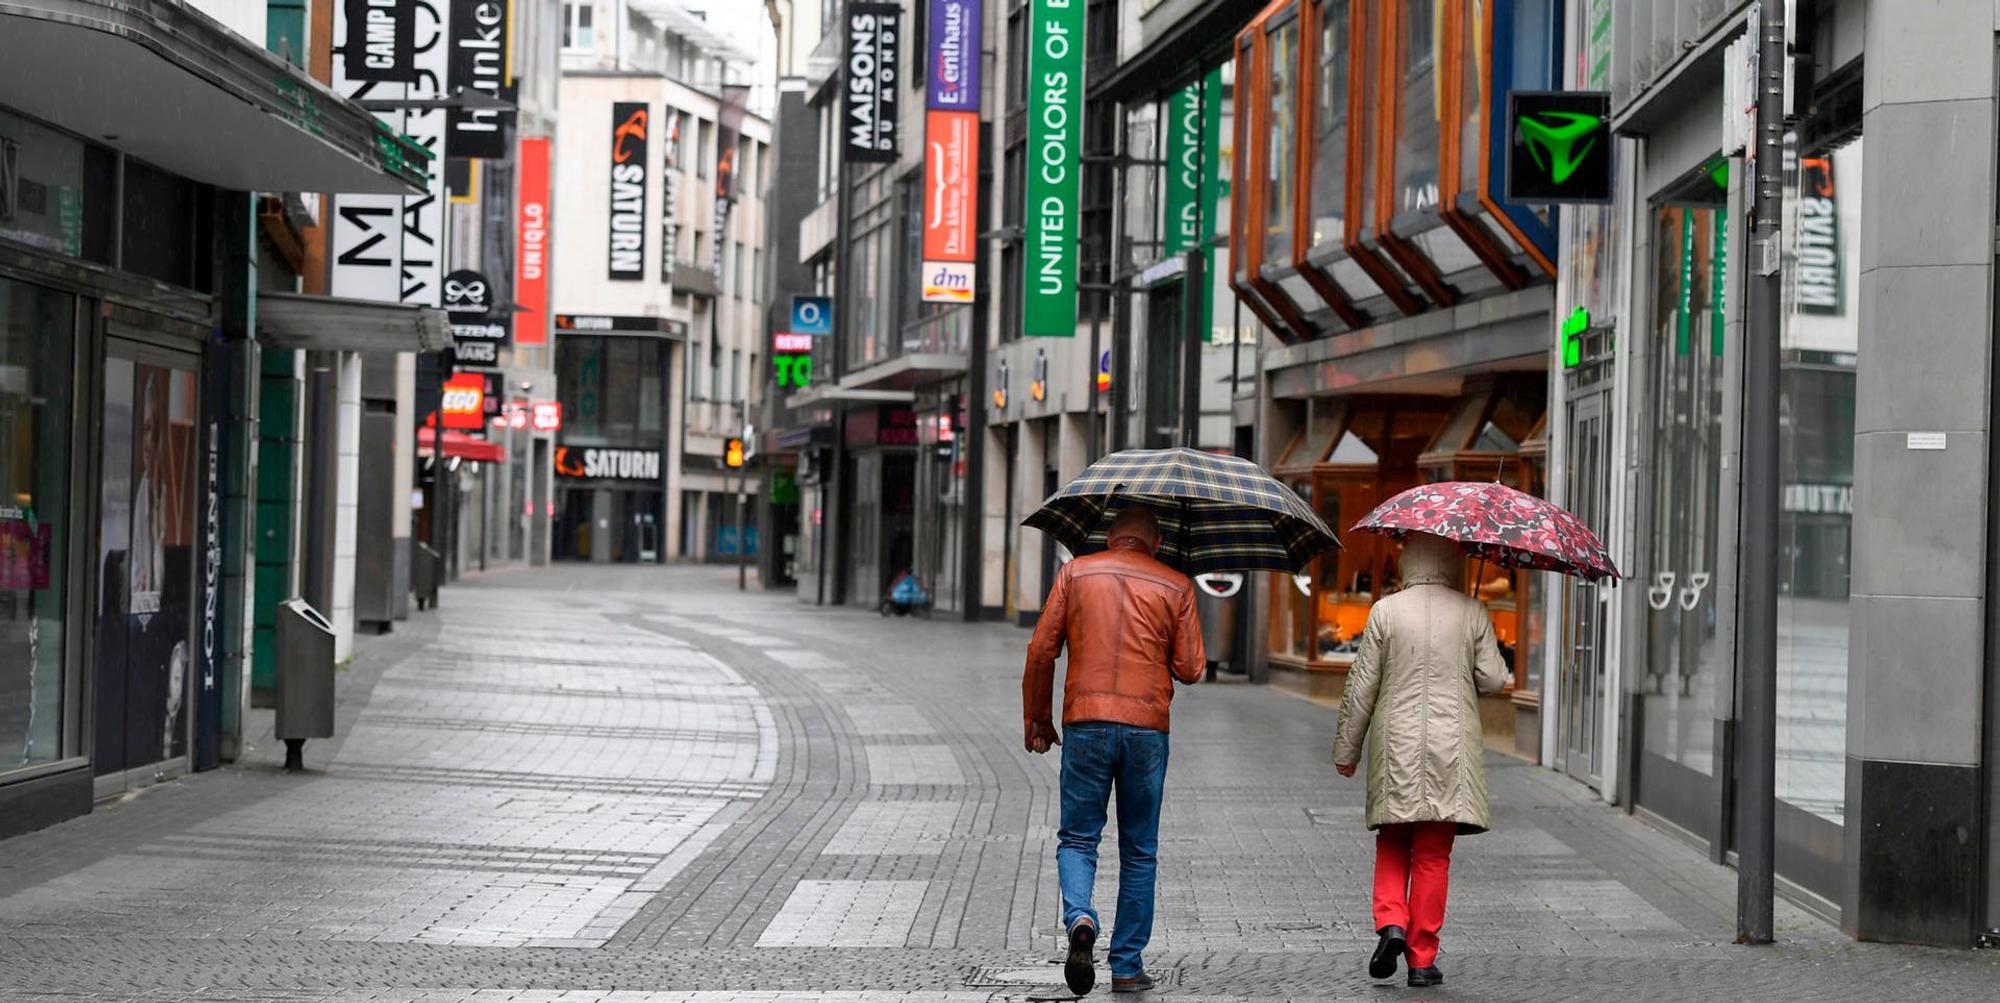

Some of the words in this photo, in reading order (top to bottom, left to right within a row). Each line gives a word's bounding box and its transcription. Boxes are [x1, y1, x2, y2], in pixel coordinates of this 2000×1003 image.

[365, 9, 395, 69] CAMP
[881, 15, 896, 103] MONDE
[1045, 21, 1070, 60] OF
[850, 13, 876, 150] MAISONS
[879, 120, 894, 150] DU
[1042, 72, 1068, 185] COLORS
[522, 202, 544, 280] UNIQLO
[611, 164, 644, 272] SATURN
[1040, 196, 1064, 295] UNITED
[933, 268, 967, 287] dm
[454, 341, 495, 361] VANS
[584, 450, 660, 479] SATURN
[203, 422, 218, 691] LONGINES
